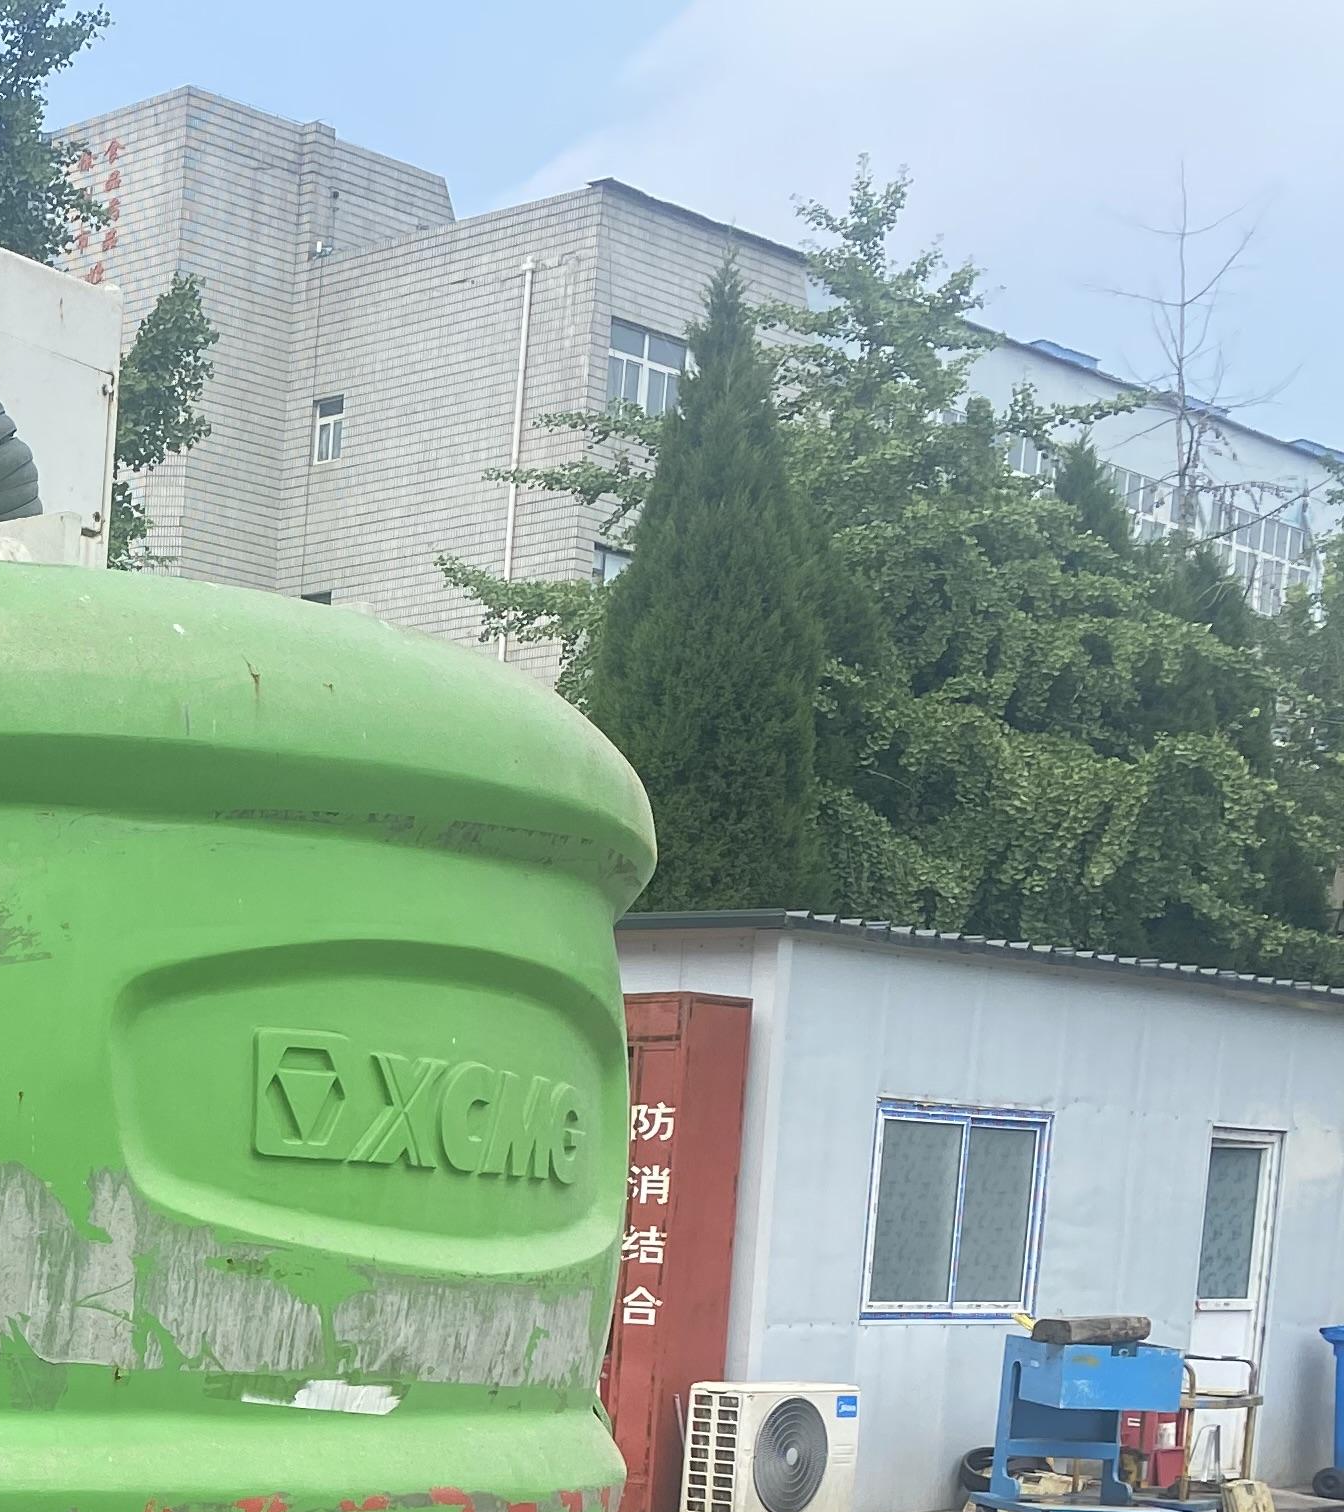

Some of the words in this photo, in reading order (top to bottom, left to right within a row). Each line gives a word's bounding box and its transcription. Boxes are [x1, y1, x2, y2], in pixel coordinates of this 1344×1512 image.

[345, 1050, 587, 1186] XCMG
[620, 1100, 676, 1327] 防消结合
